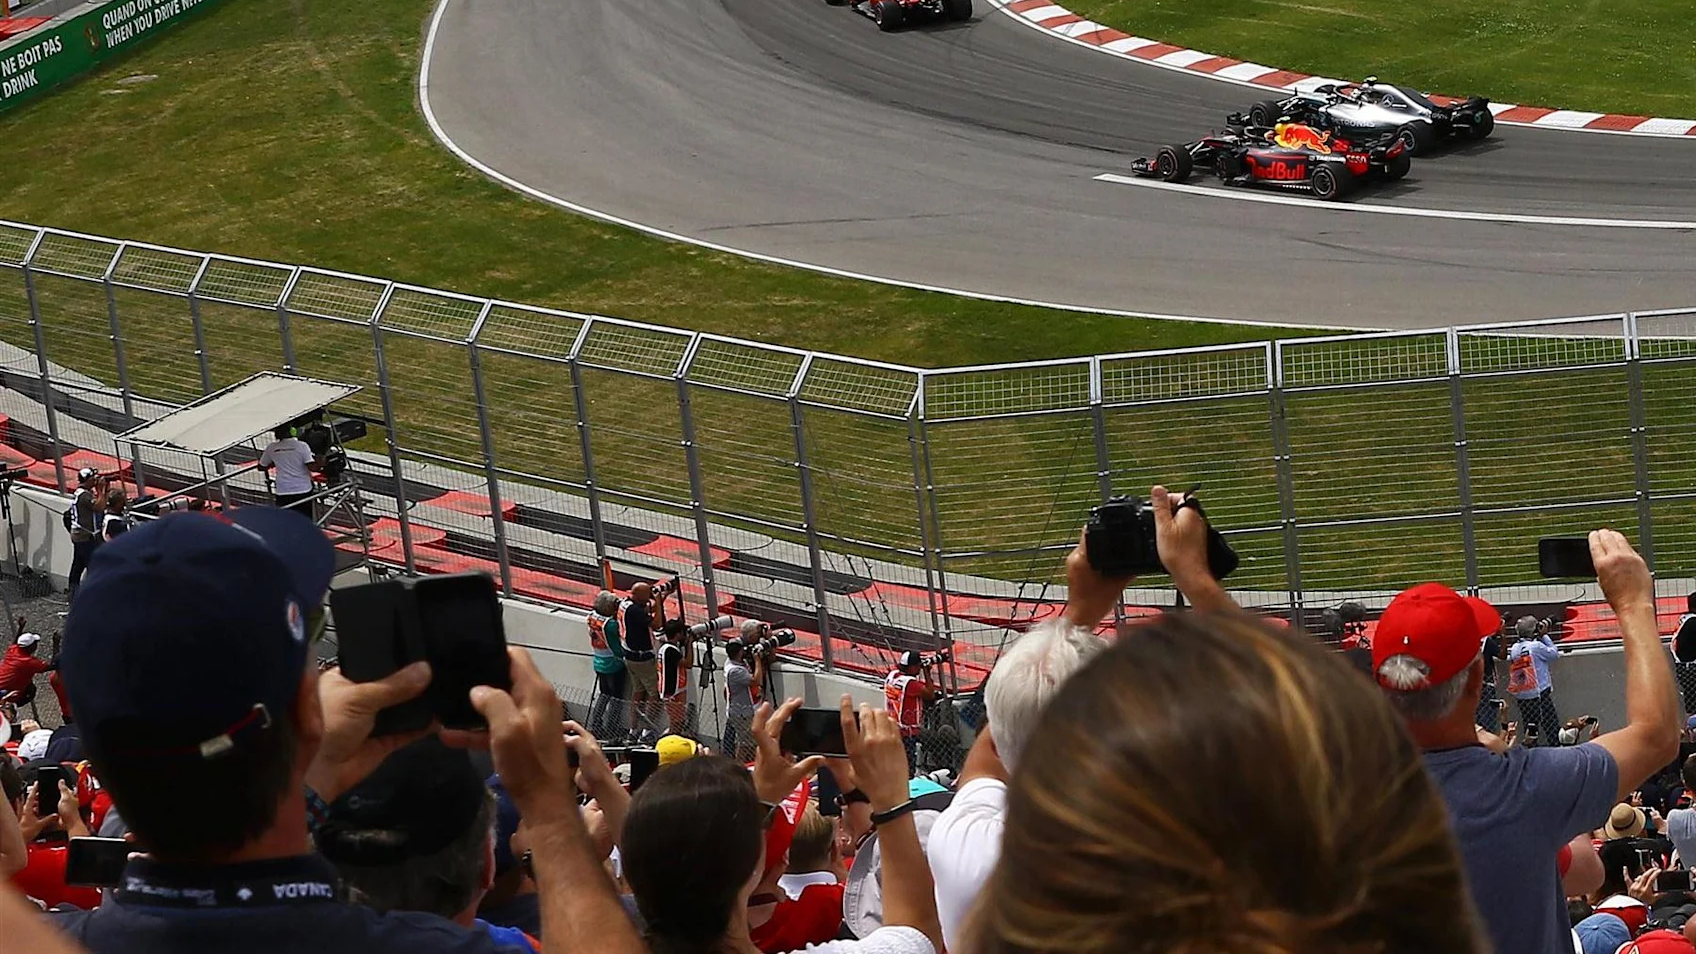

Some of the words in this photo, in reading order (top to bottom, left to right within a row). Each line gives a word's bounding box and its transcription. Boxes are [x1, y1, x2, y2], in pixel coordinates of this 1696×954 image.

[102, 1, 136, 30] QUAND
[105, 23, 133, 49] WHEN
[133, 13, 153, 34] YOU
[154, 0, 181, 25] DRIVE
[1, 52, 18, 78] NE
[16, 43, 43, 70] BOIT
[43, 35, 63, 57] PAS
[2, 69, 38, 98] DRINK
[272, 882, 333, 899] CANADA
